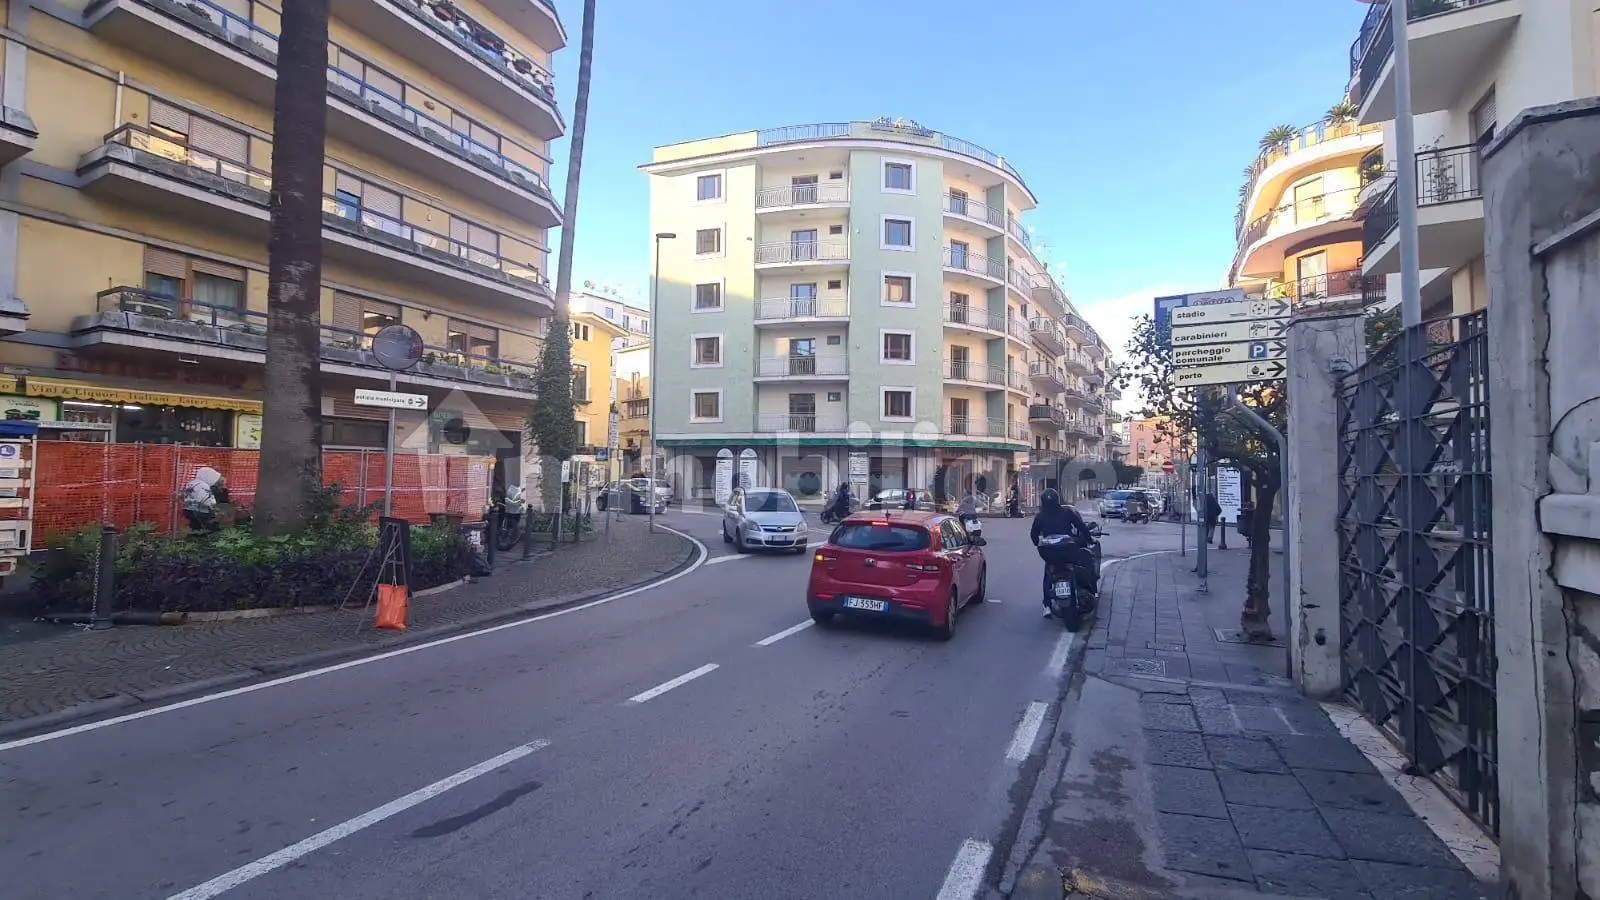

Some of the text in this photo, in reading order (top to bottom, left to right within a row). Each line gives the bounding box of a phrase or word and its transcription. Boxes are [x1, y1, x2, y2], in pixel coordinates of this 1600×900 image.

[1177, 310, 1205, 318] stadio
[1174, 331, 1227, 341] carabinieri
[1175, 347, 1230, 358] parcheggio
[1253, 345, 1264, 357] P
[1175, 356, 1223, 364] comunale
[30, 384, 58, 394] Vini
